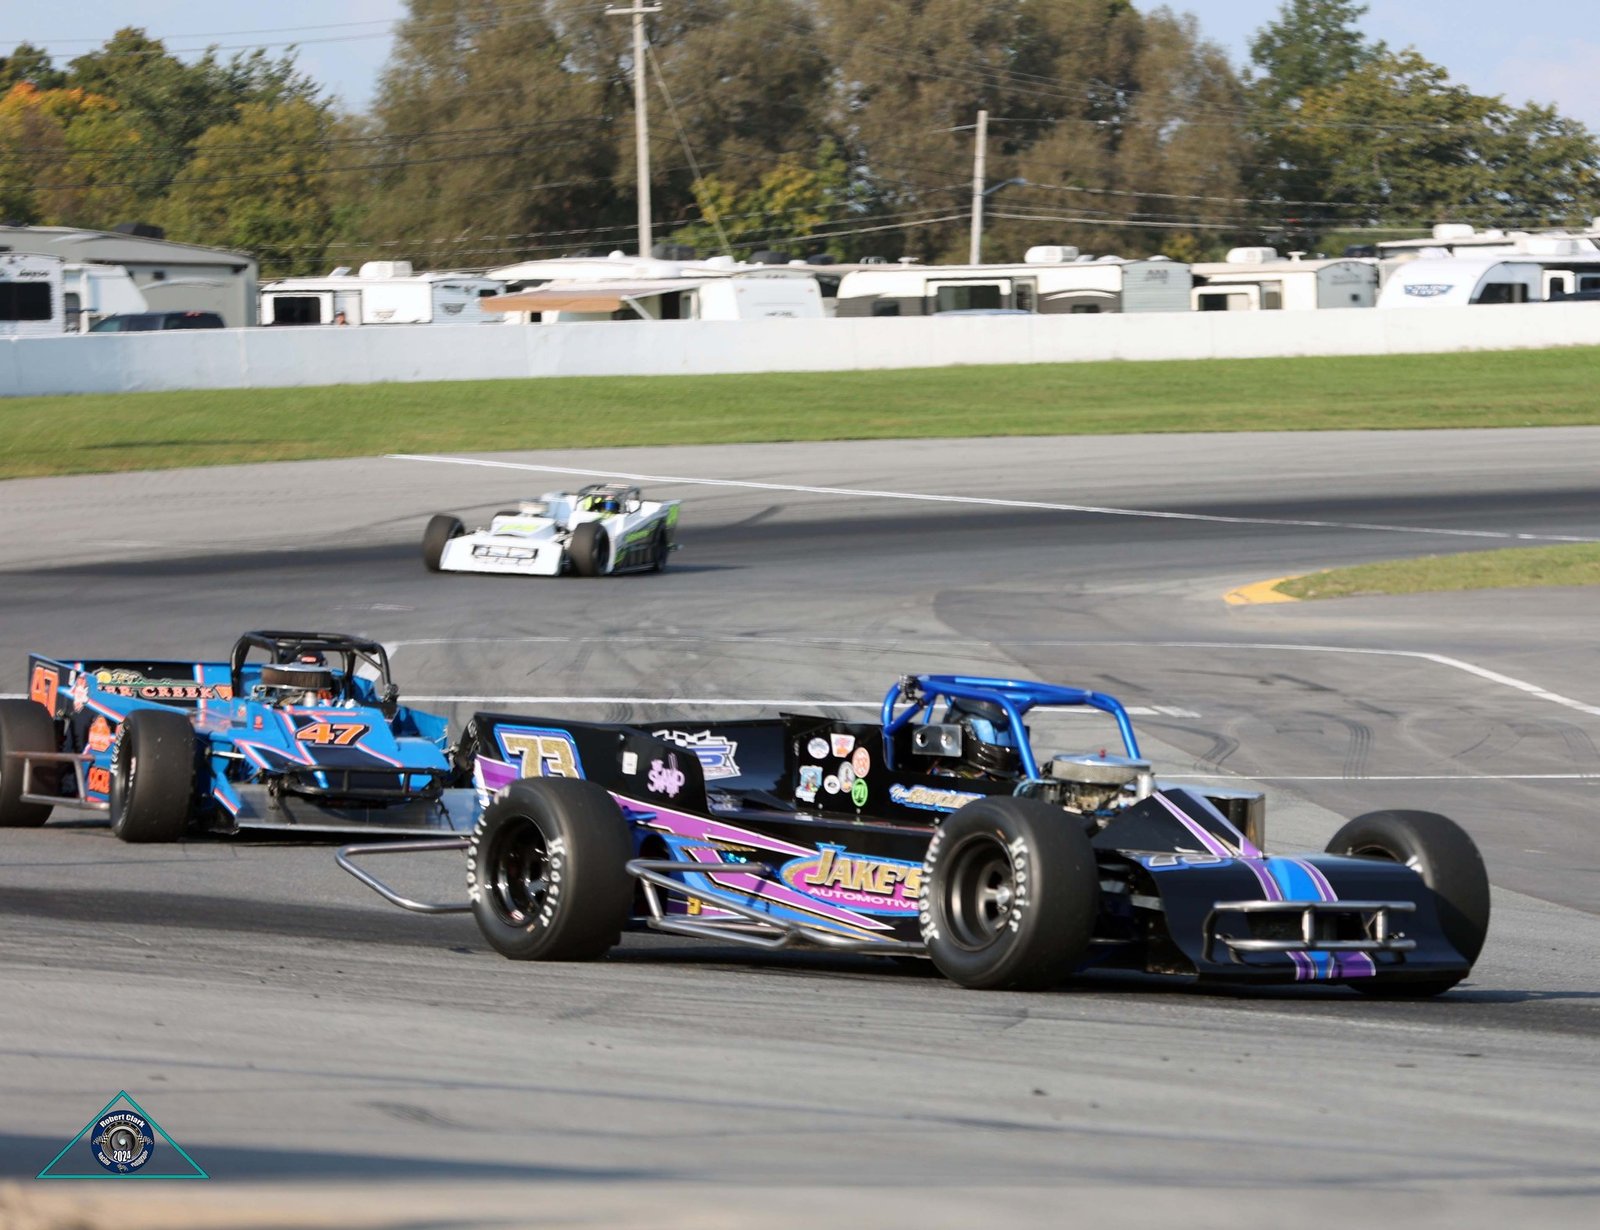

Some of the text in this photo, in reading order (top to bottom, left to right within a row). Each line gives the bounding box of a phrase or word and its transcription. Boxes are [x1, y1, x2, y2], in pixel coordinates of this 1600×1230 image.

[141, 687, 215, 699] CREEK
[296, 723, 368, 745] 47
[500, 732, 580, 779] 73
[540, 837, 567, 928] Hoosier
[808, 888, 920, 910] AUTOMOTIVE
[1008, 837, 1029, 933] Hoosier
